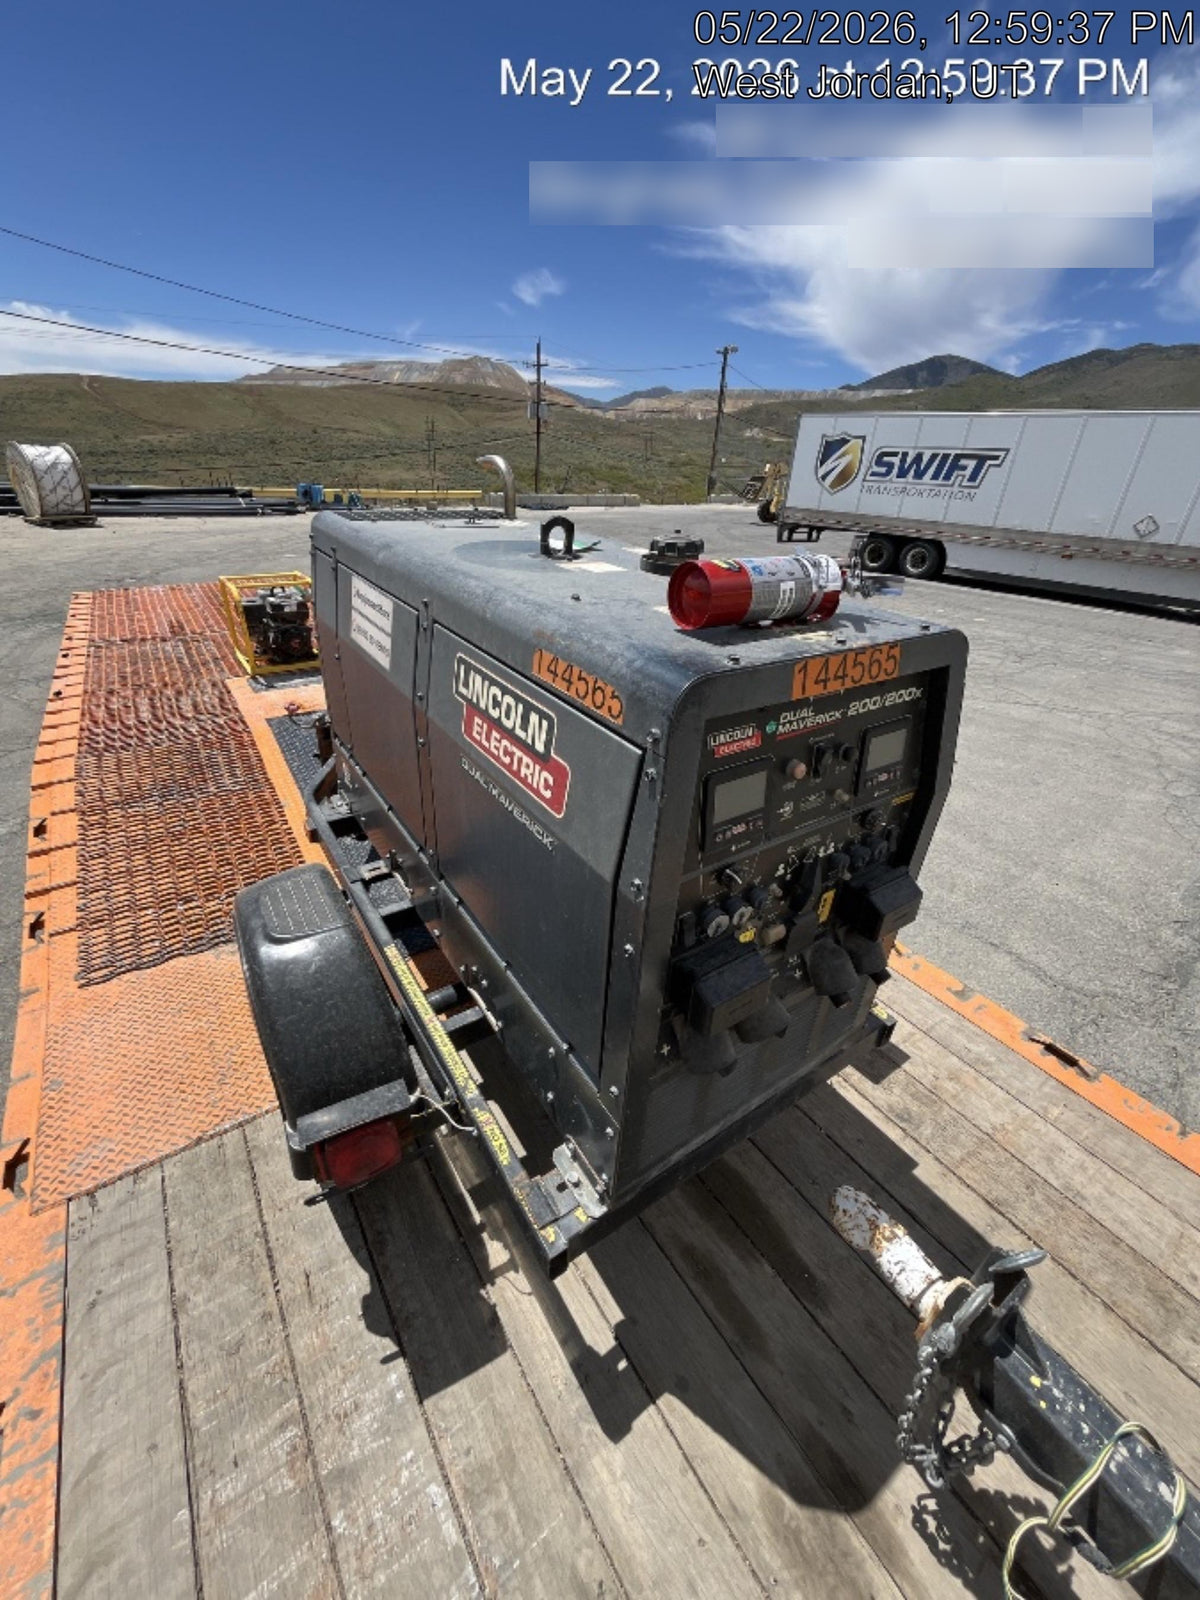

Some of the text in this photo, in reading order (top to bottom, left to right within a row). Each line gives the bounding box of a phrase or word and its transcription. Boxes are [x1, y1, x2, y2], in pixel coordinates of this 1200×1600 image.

[867, 448, 1004, 486] SWIFT
[860, 484, 977, 502] TRANSPORTATION
[537, 648, 623, 719] 144565
[796, 645, 899, 696] 144565
[458, 664, 549, 753] LINCOLN
[777, 709, 843, 735] MAVERICK
[780, 706, 815, 722] DUAL
[710, 726, 754, 746] LINCOLN
[472, 716, 554, 799] ELECTRIC
